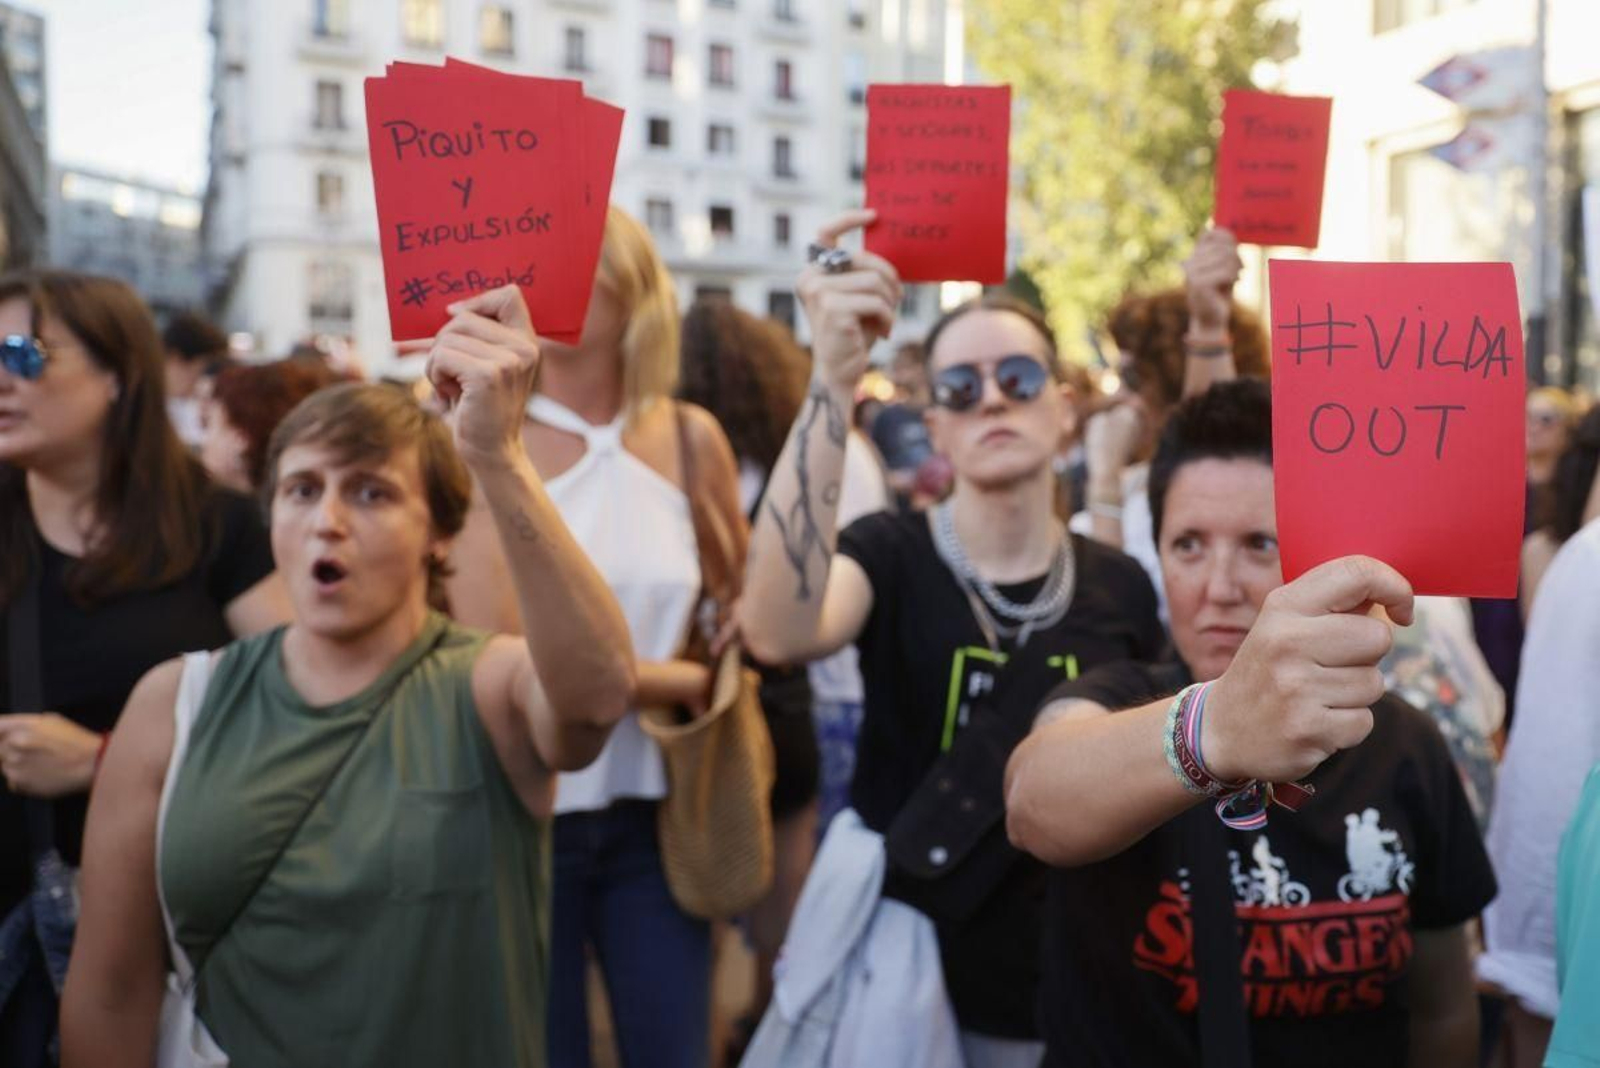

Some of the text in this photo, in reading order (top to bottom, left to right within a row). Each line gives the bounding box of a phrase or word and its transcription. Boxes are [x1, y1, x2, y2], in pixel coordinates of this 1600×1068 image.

[395, 207, 552, 253] EXPULSIÓN
[1308, 402, 1467, 460] OUT
[1132, 895, 1414, 978] SANGER
